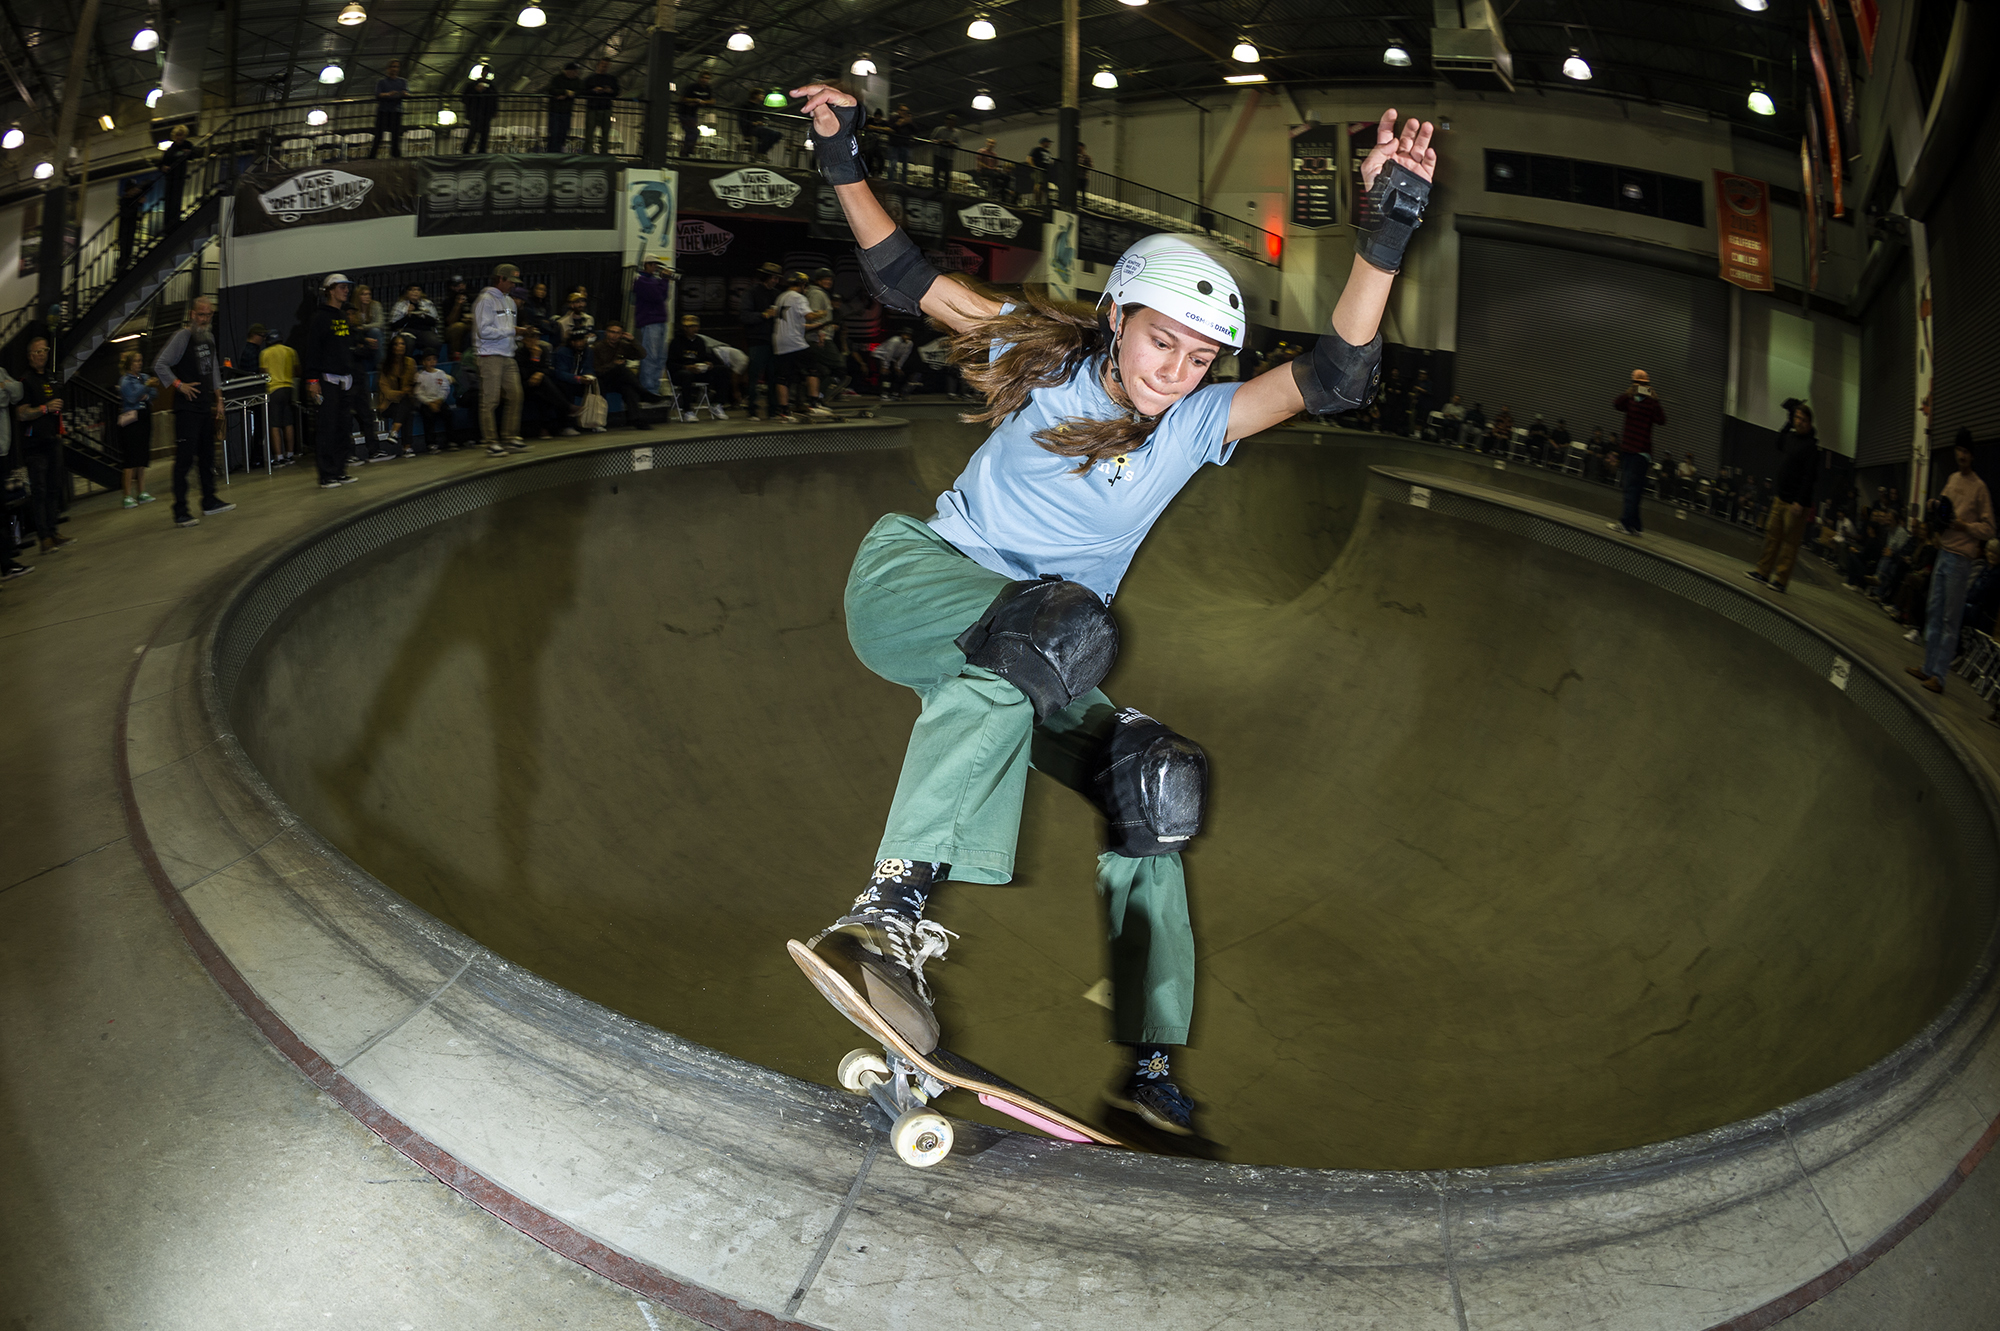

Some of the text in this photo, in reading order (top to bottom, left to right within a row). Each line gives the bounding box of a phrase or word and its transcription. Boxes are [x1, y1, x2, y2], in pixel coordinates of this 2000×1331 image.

[293, 171, 335, 191] VANS
[738, 171, 771, 184] VANS
[297, 188, 329, 208] THE
[743, 184, 766, 200] THE
[677, 221, 705, 235] VANS
[678, 234, 701, 250] THE
[1185, 312, 1234, 338] COSMOS DIREKT
